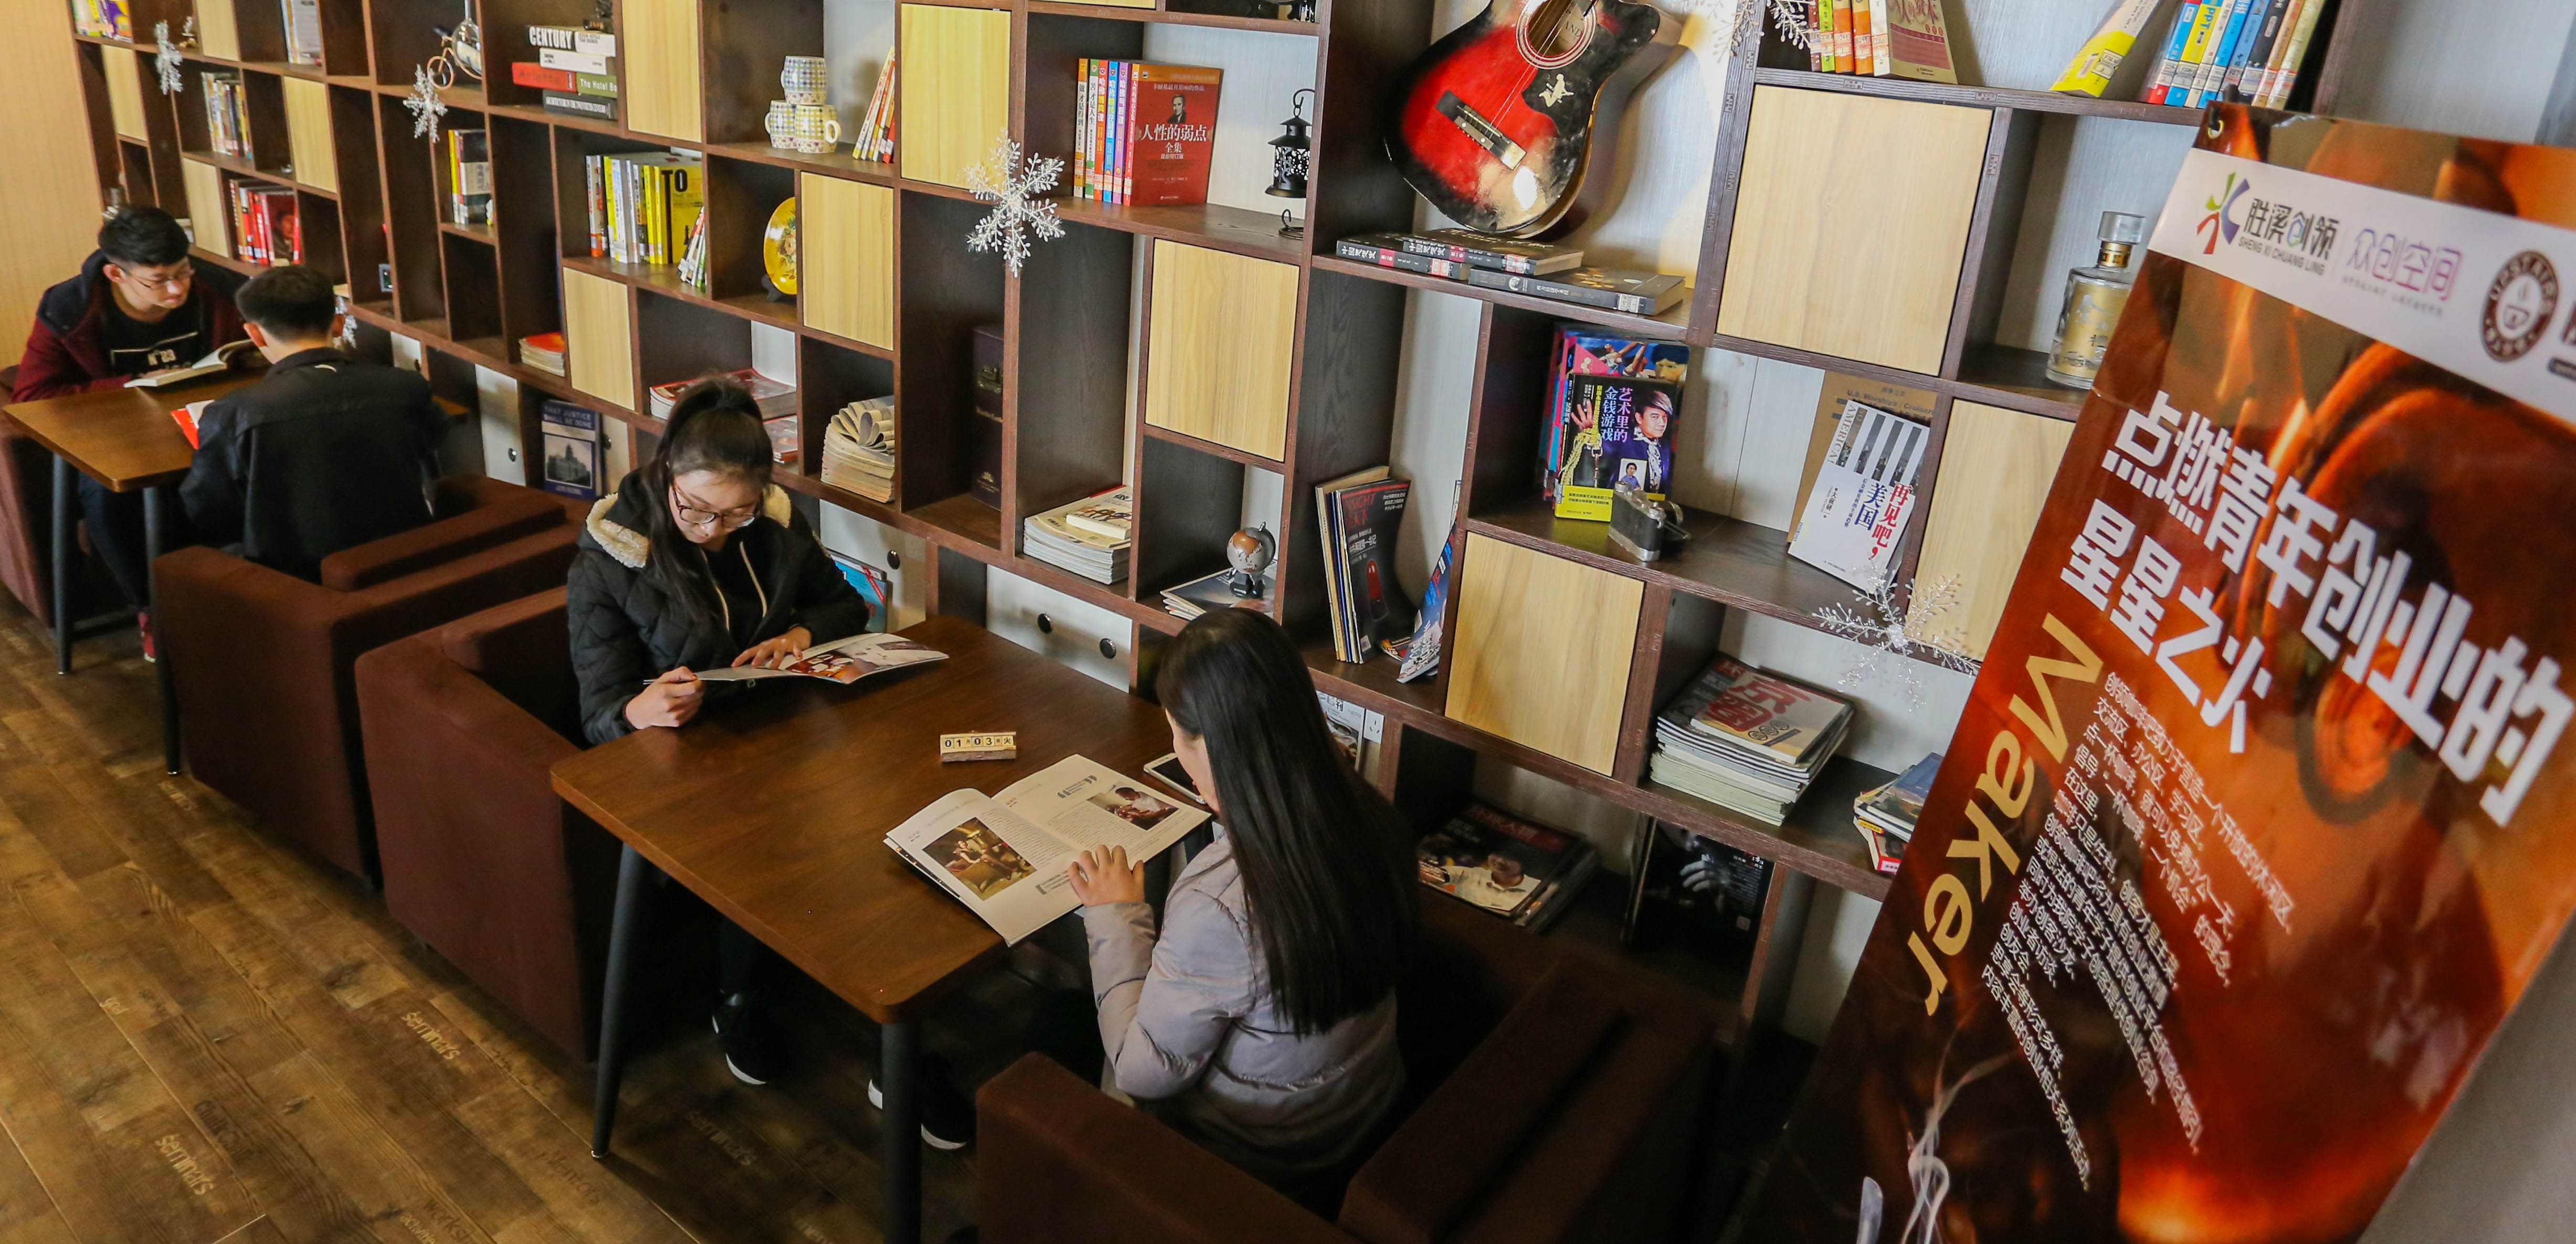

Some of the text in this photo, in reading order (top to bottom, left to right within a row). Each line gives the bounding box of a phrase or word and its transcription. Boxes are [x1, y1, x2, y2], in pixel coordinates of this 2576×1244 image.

[529, 26, 572, 49] CENTURY
[2201, 7, 2216, 29] PPT
[580, 79, 590, 89] The
[593, 81, 608, 91] Hotel
[1141, 124, 1207, 142] 人性的弱点
[1165, 142, 1183, 153] 全集
[2239, 236, 2325, 276] SHENG XI CHUANG LING
[2244, 197, 2340, 260] 胜溪创领
[2346, 227, 2463, 301] 众创空间
[1601, 386, 1619, 441] 金钱游戏
[1614, 387, 1633, 442] 艺术里的
[1827, 404, 1857, 464] AMERICA!
[1854, 481, 1888, 531] 美国
[2060, 499, 2273, 754] 星星之火
[2102, 389, 2574, 828] 点燃青年创业的
[2064, 767, 2099, 820] 在这里，
[2094, 696, 2204, 850] 交流区、办公区、学习区。
[1907, 614, 2104, 1016] Maker
[2019, 878, 2075, 981] 举办创客沙龙、
[2045, 813, 2169, 1010] 创领咖啡吧将为具有创业激情
[2000, 923, 2030, 981] 创友会、
[2009, 901, 2057, 988] 创业者访谈、
[401, 1010, 460, 1060] seminars
[1991, 942, 2064, 1080] 思享会等形式多样、
[1981, 964, 2090, 1192] 内容丰富的创业相关系列活动。
[155, 1134, 216, 1195] seminars
[684, 1109, 758, 1167] seminars
